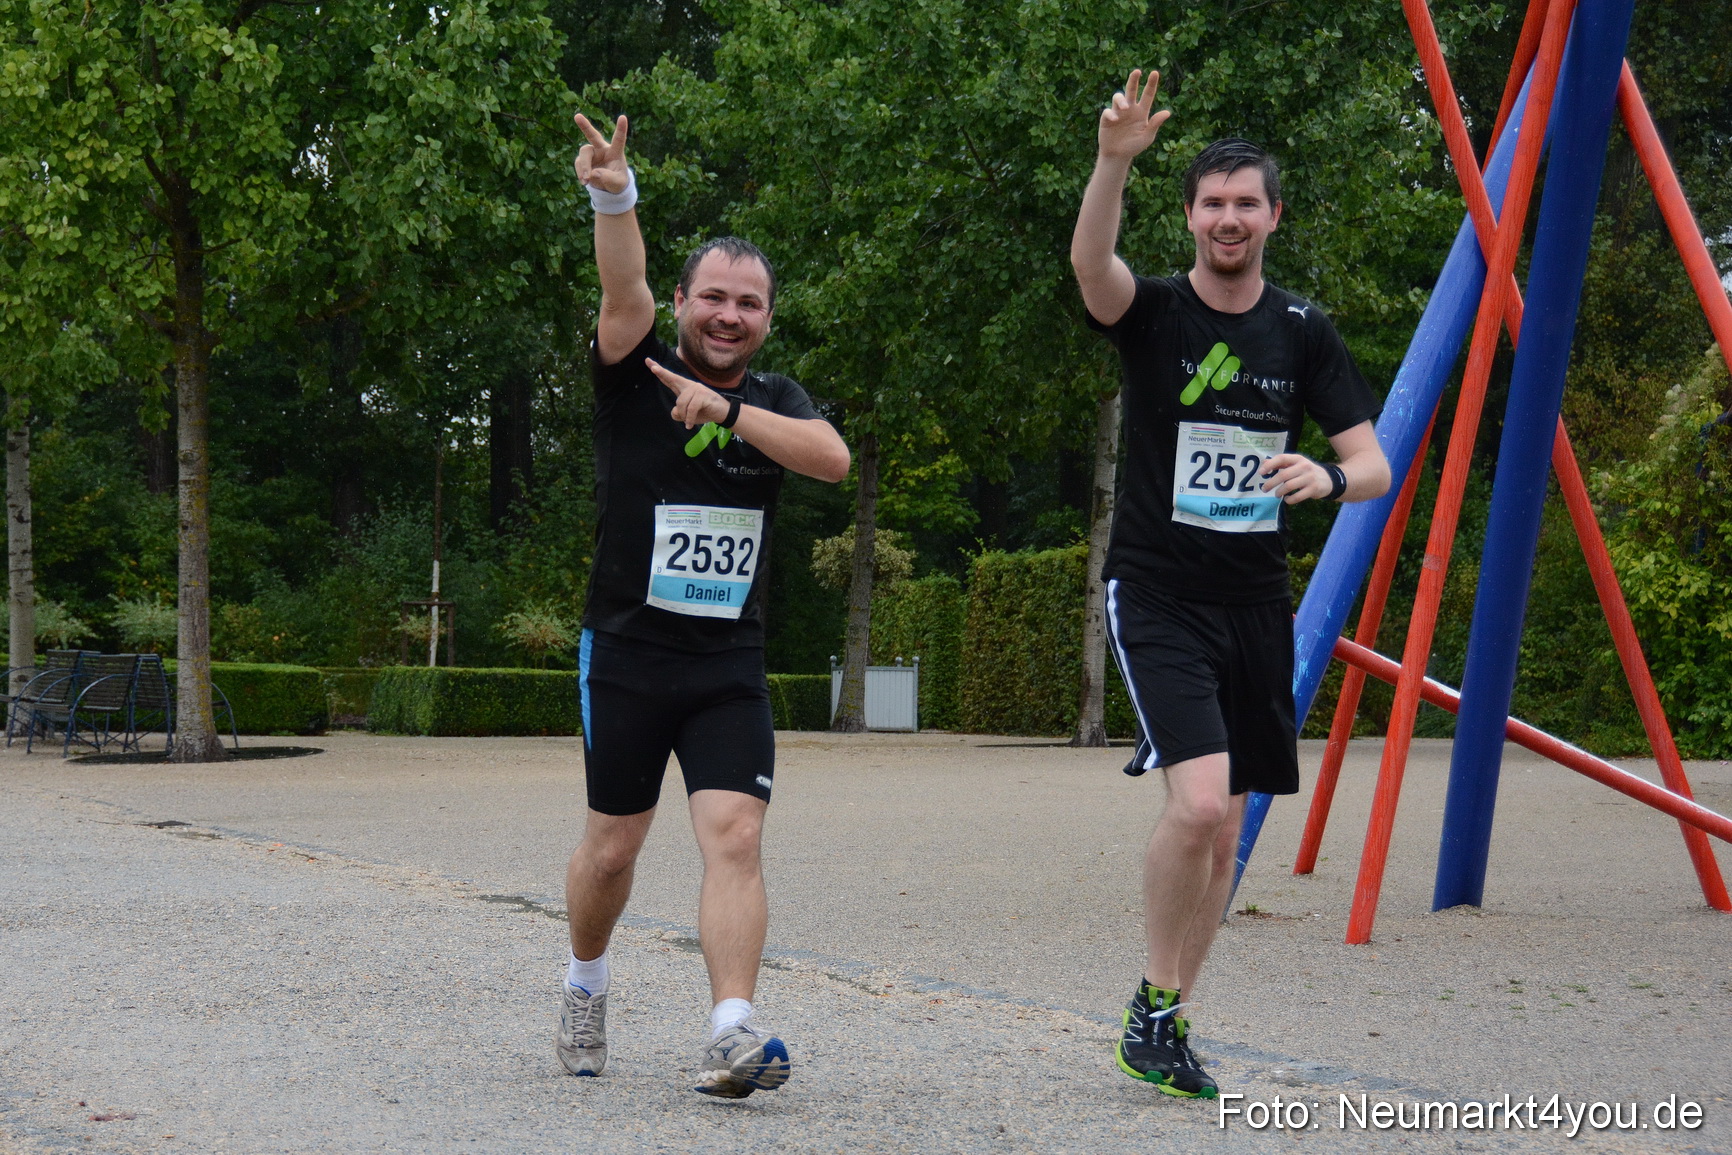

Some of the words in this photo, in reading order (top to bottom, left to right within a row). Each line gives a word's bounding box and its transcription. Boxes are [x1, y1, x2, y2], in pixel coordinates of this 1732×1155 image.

[1214, 404, 1240, 418] Secure
[1241, 409, 1265, 421] Cloud
[1188, 434, 1226, 445] NeuerMarkt
[1232, 430, 1277, 448] BCK
[1209, 502, 1255, 517] Daniel
[665, 518, 702, 526] NeuerMarkt
[708, 511, 756, 528] BOCK
[666, 532, 754, 577] 2532
[684, 583, 731, 602] Daniel
